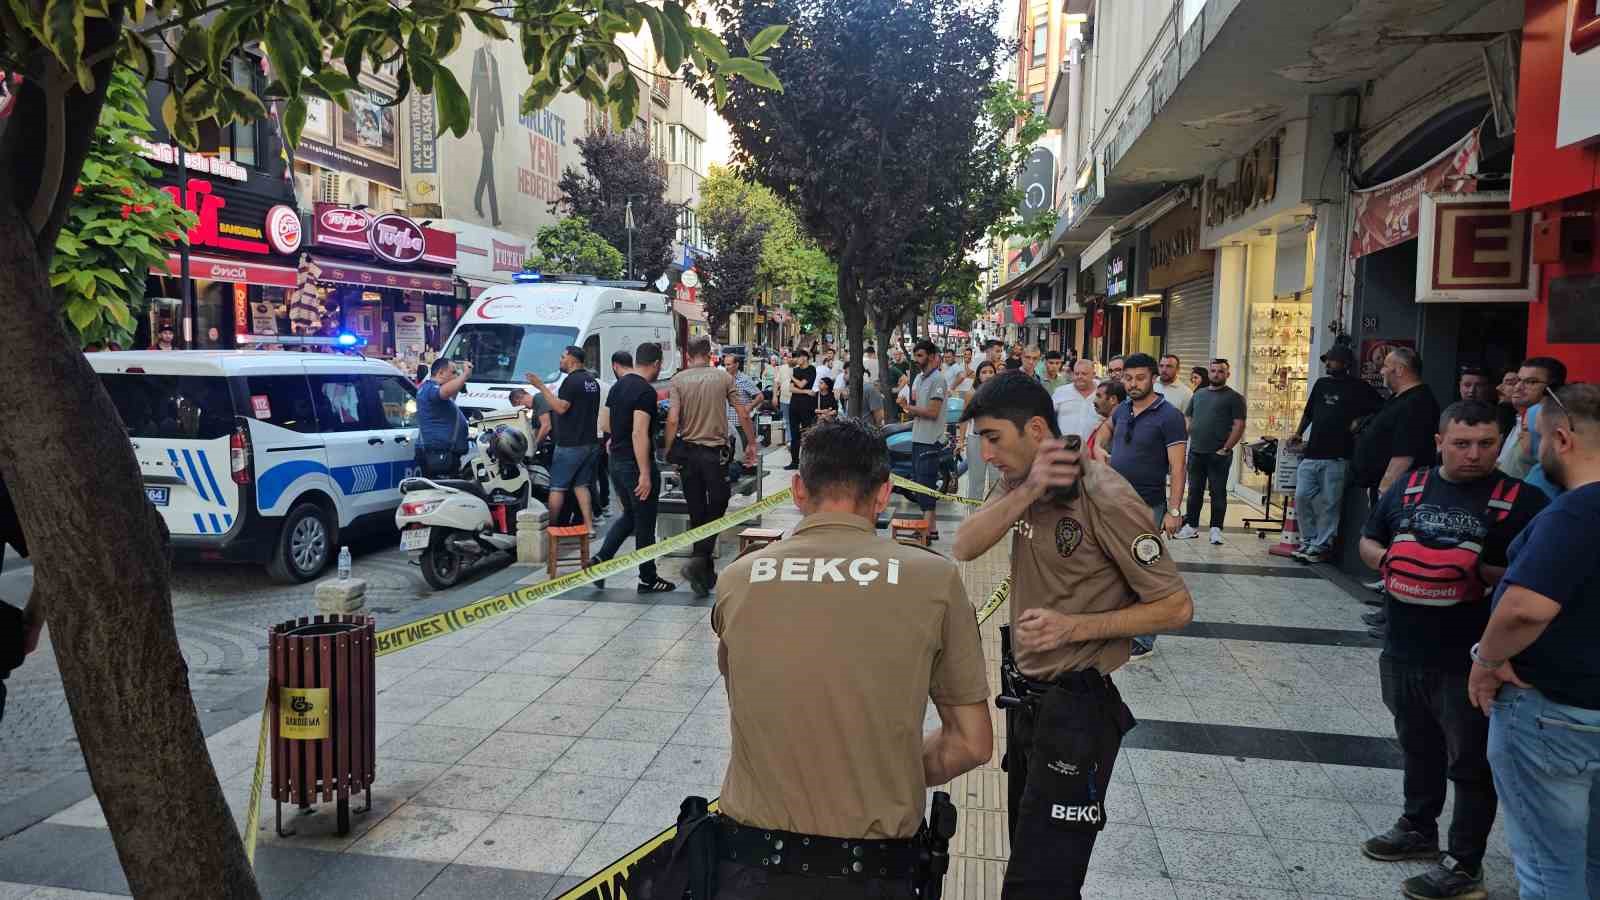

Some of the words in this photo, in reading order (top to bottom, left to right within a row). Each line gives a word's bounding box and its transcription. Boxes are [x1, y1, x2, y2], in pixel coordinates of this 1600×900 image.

[529, 132, 560, 180] YENİ
[254, 398, 269, 410] 112
[750, 557, 900, 586] BEKÇİ
[1389, 577, 1457, 598] Yemeksepeti
